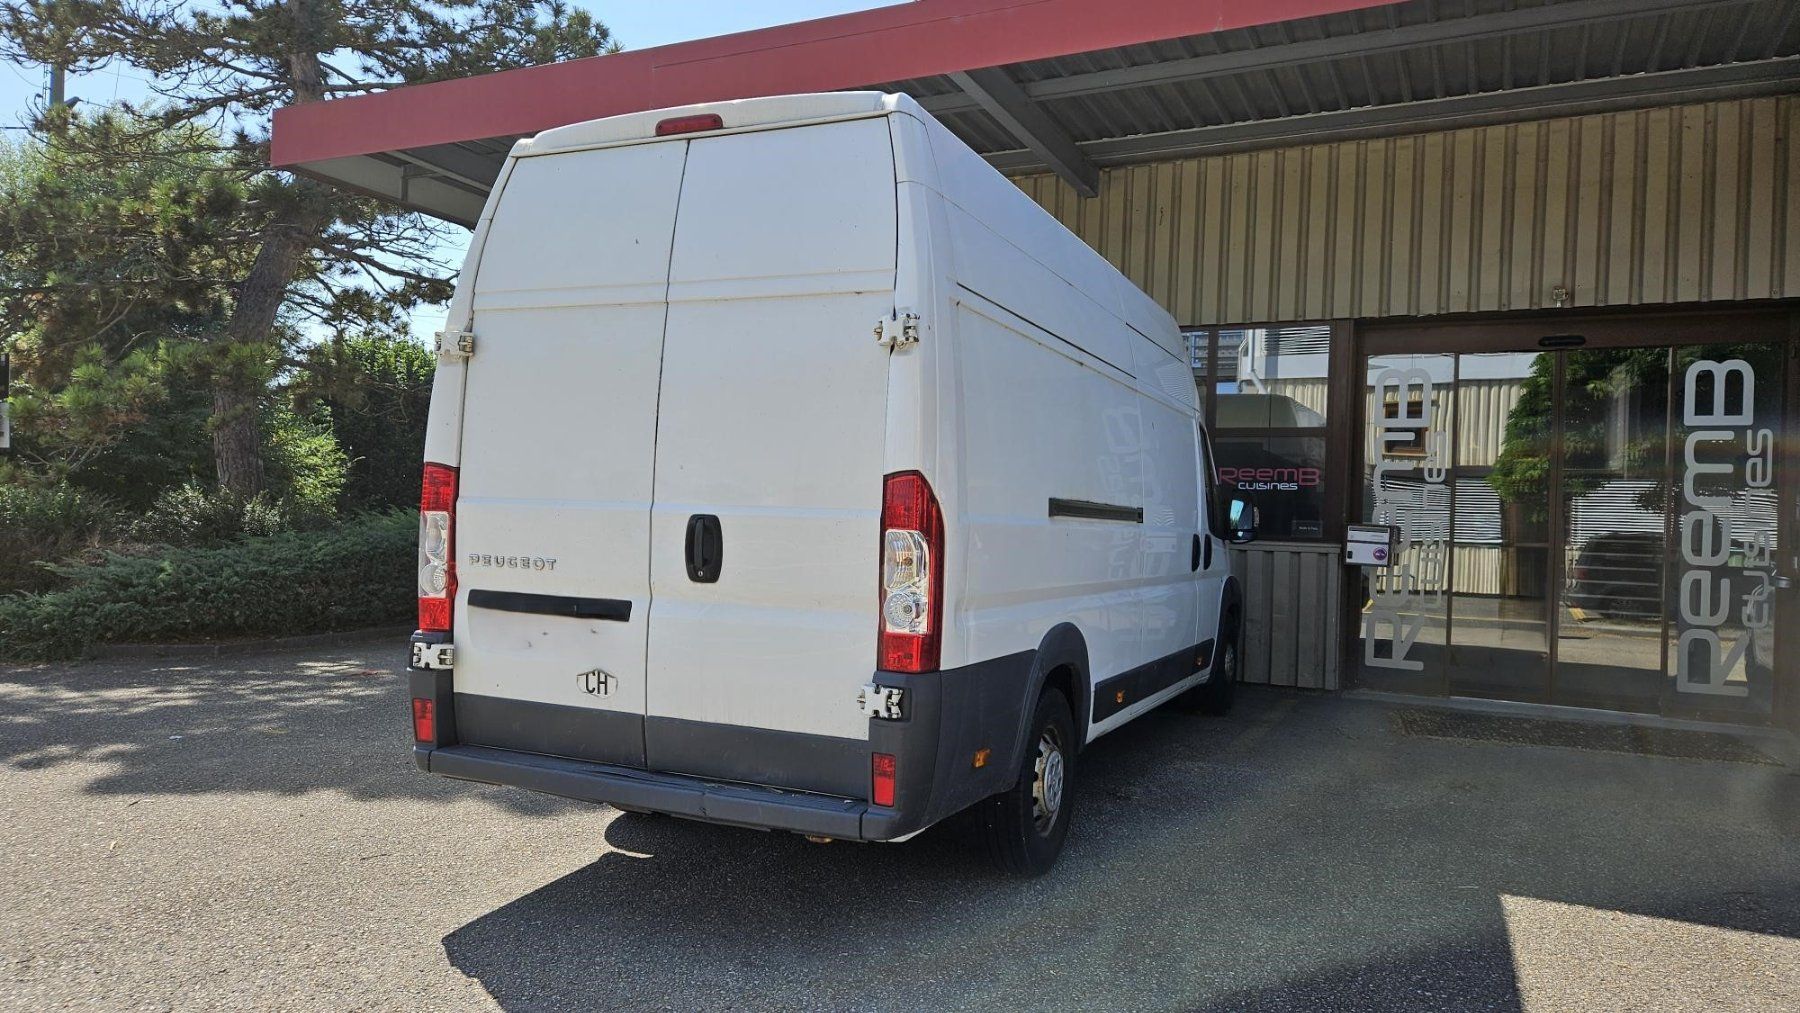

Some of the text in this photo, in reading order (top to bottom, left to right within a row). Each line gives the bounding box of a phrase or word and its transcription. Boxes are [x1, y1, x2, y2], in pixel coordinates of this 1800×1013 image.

[1218, 467, 1321, 486] ReemB
[1365, 367, 1432, 672] ReemB
[1677, 359, 1755, 697] ReemB
[469, 553, 557, 571] PEUGEOT
[585, 670, 608, 696] CH
